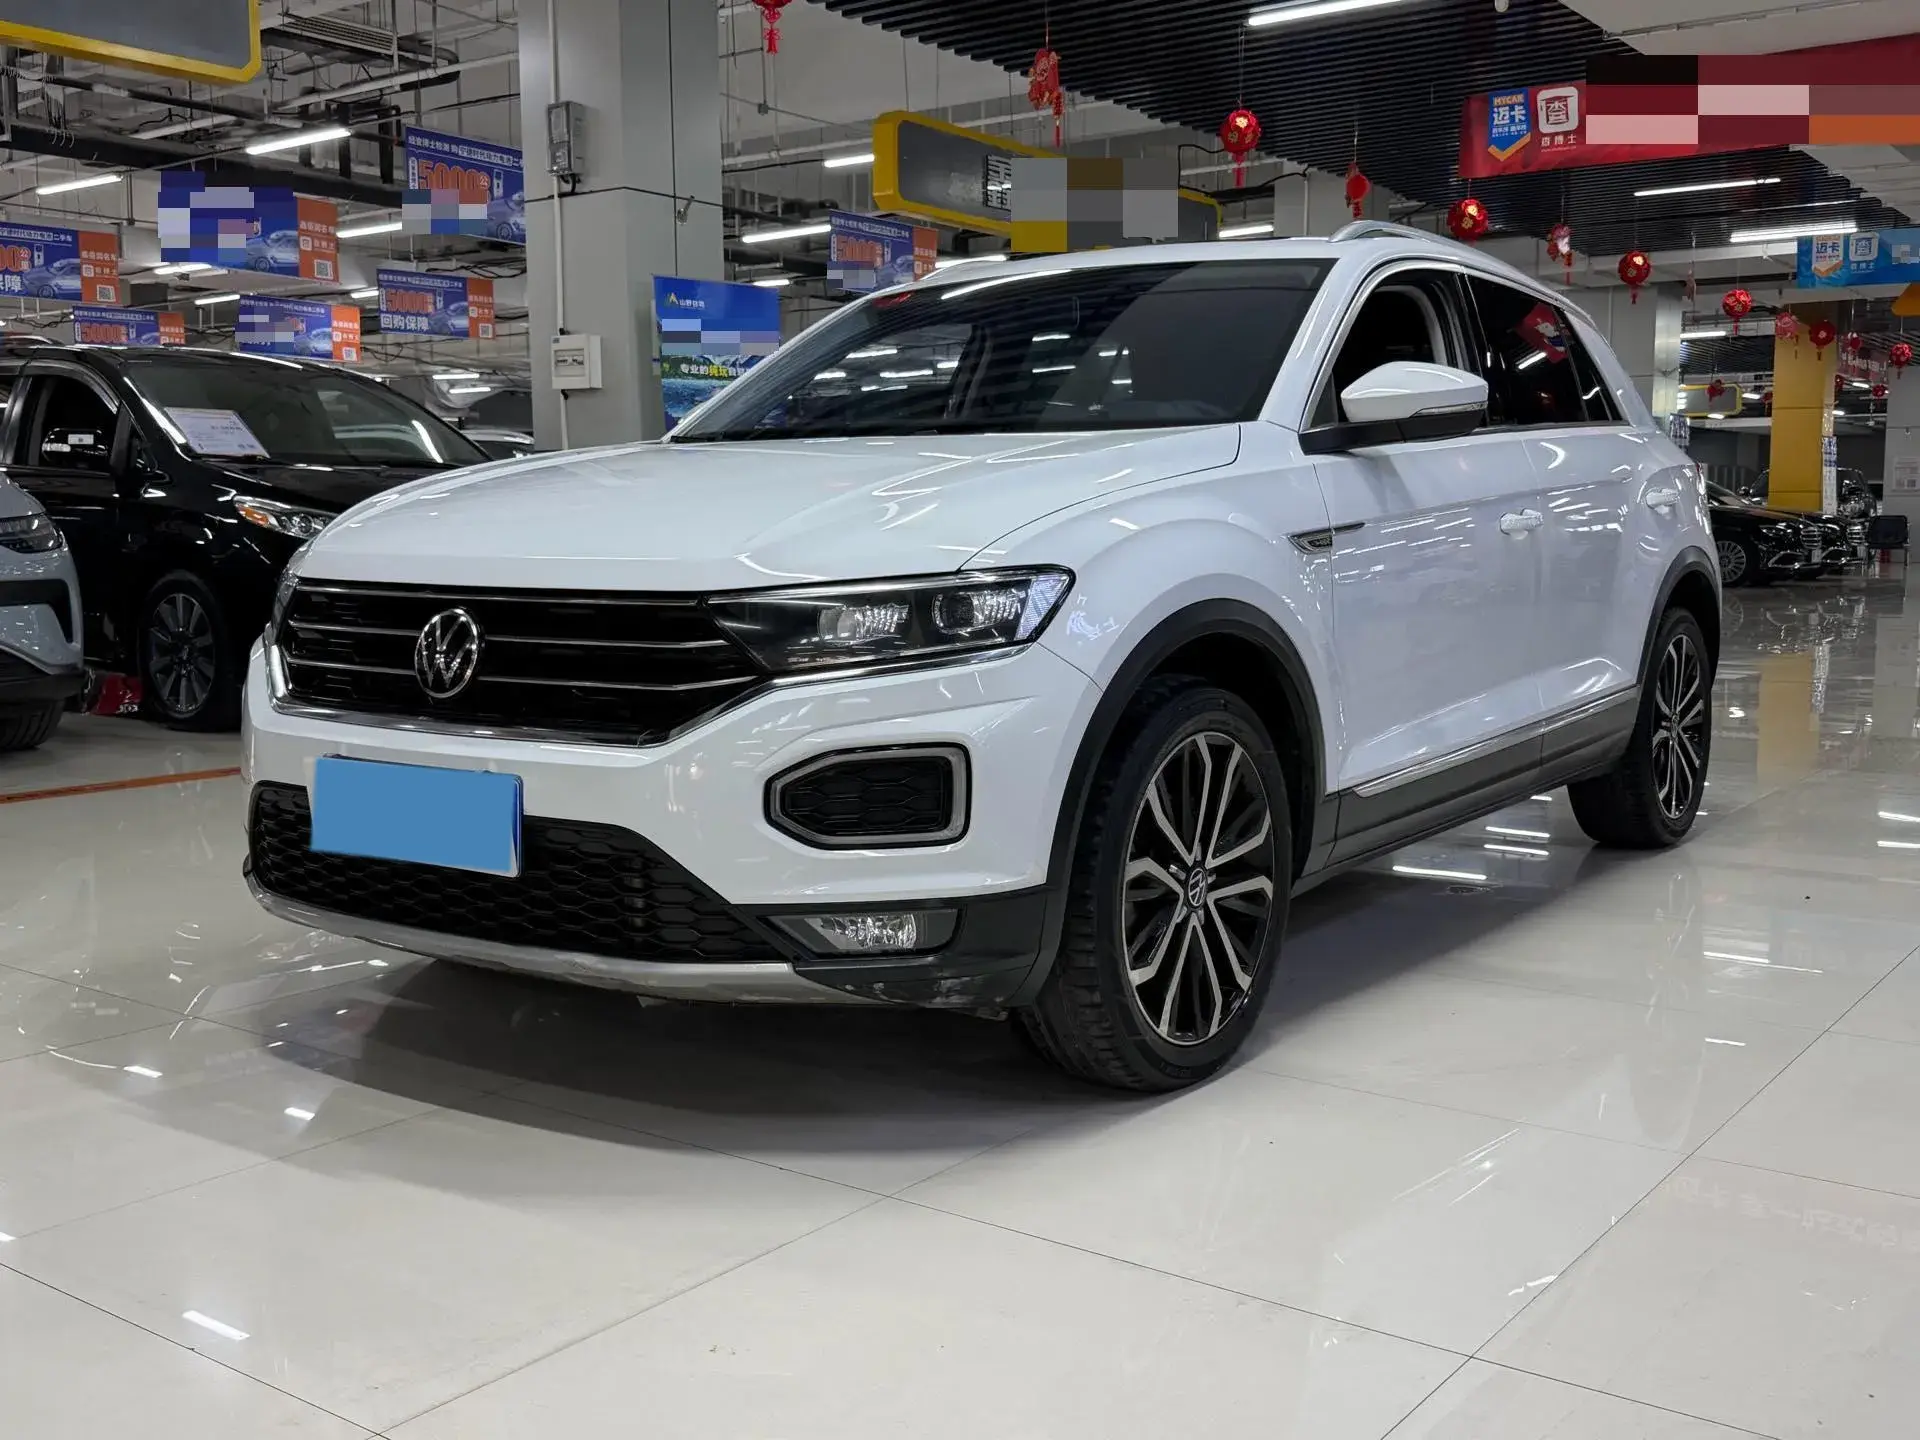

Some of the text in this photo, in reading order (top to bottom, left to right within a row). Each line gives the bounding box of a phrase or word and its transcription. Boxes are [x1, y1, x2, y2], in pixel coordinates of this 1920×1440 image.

[1493, 105, 1526, 125] 迈卡
[1816, 241, 1840, 254] 迈卡
[380, 313, 429, 331] 回购保障
